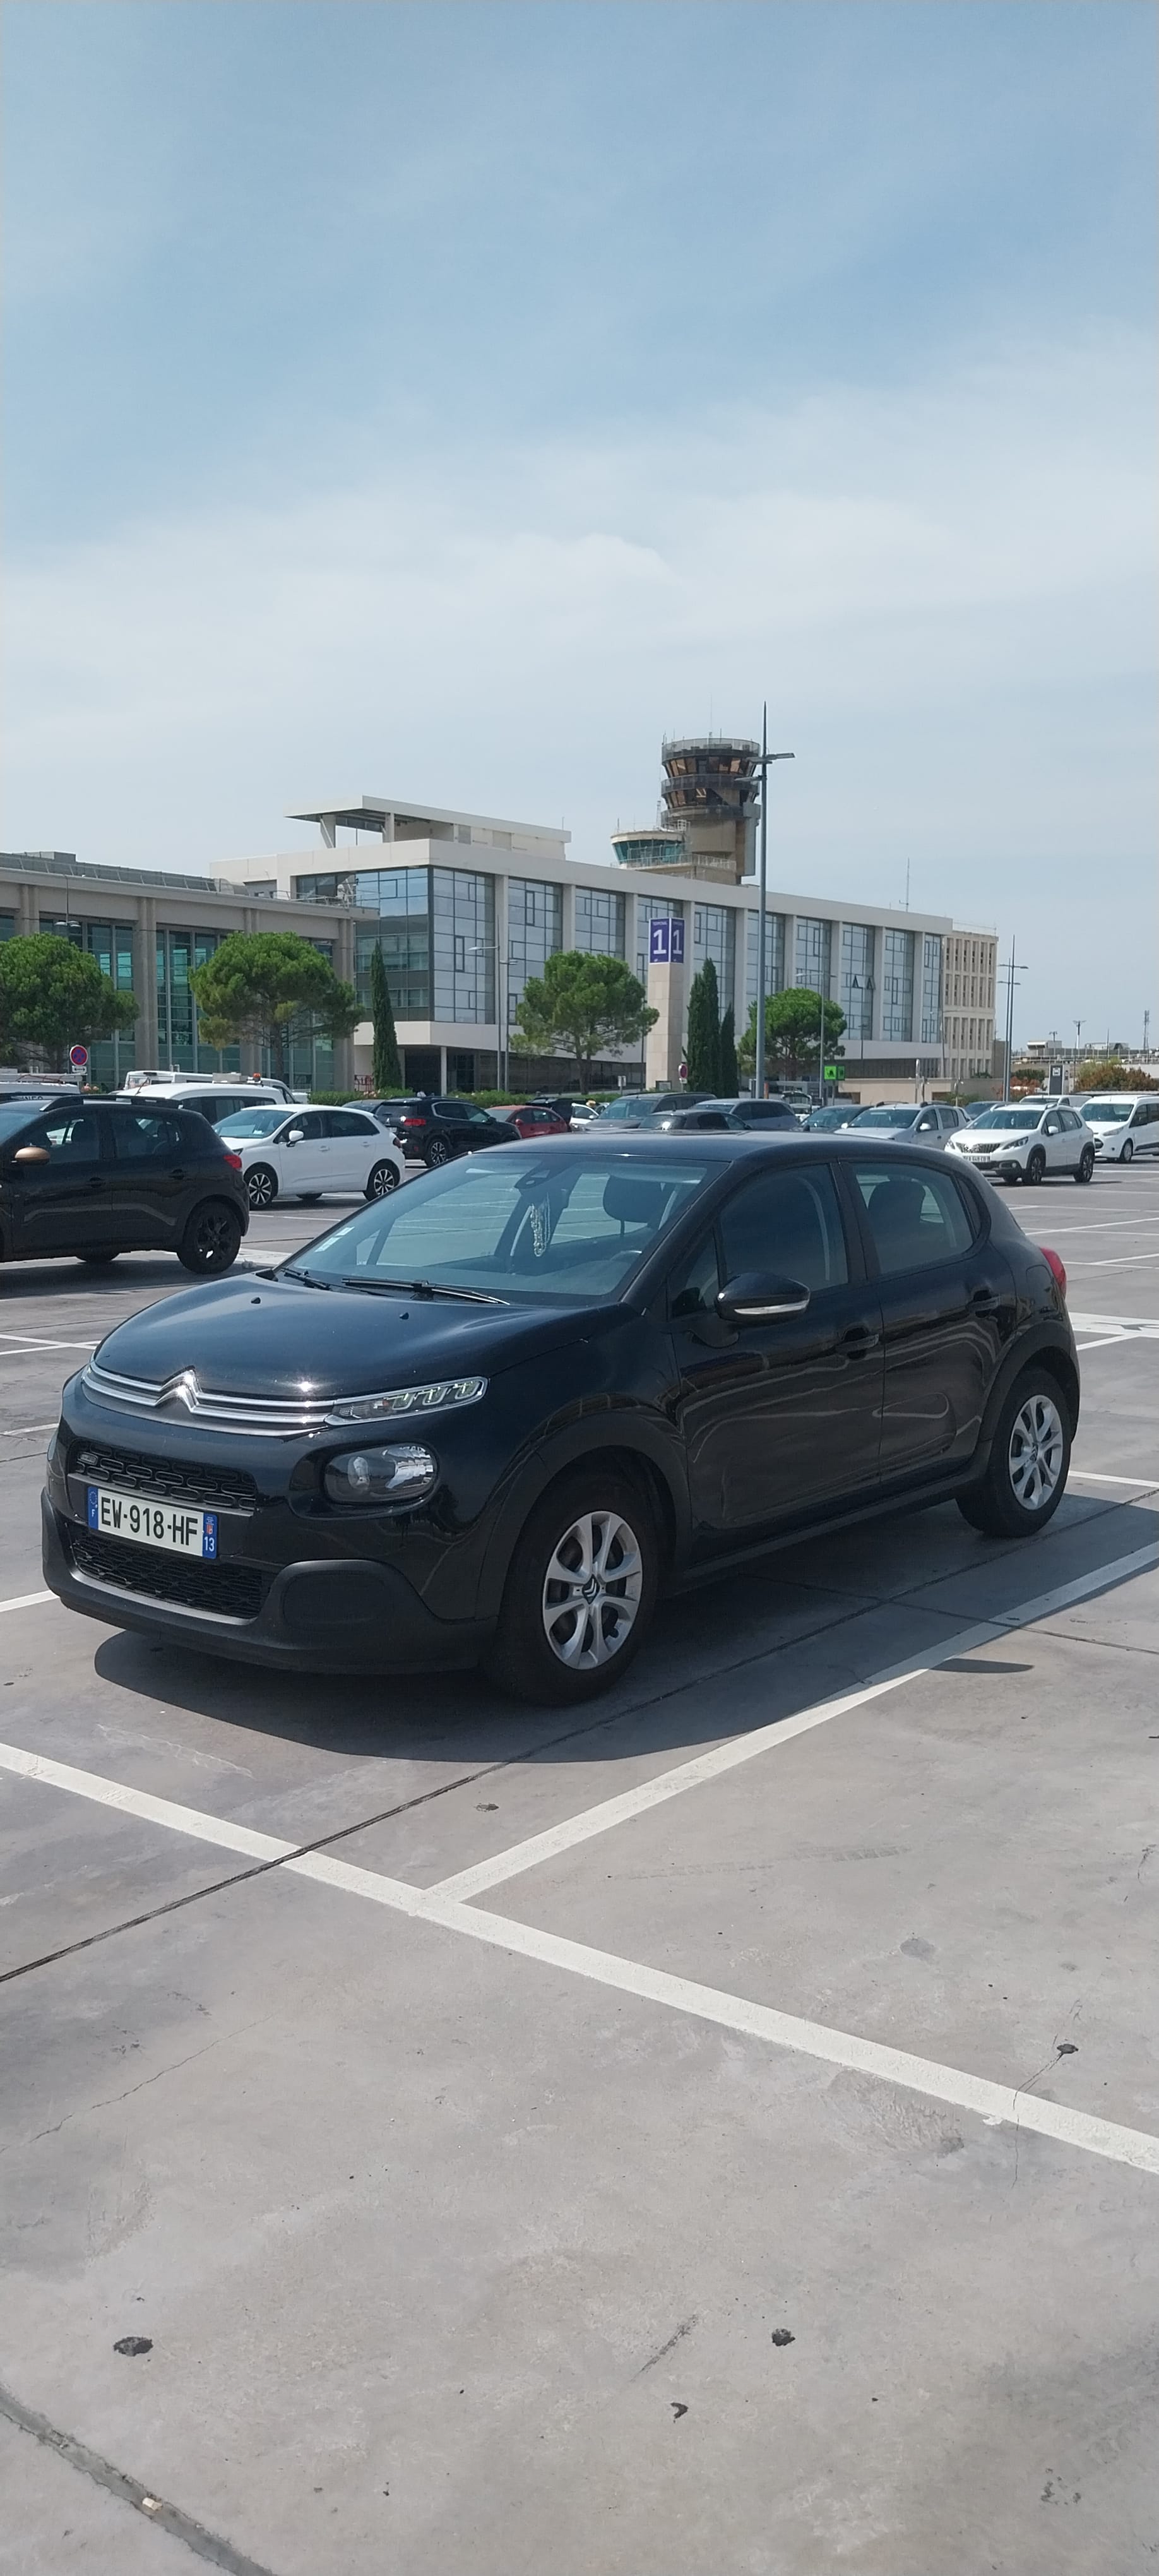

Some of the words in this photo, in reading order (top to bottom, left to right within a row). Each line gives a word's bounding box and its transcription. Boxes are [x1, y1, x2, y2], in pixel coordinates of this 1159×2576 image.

[653, 929, 667, 955] 1
[672, 929, 682, 955] 1
[92, 1508, 95, 1517] F
[101, 1496, 198, 1546] EW-918-HF
[204, 1536, 215, 1552] 13
